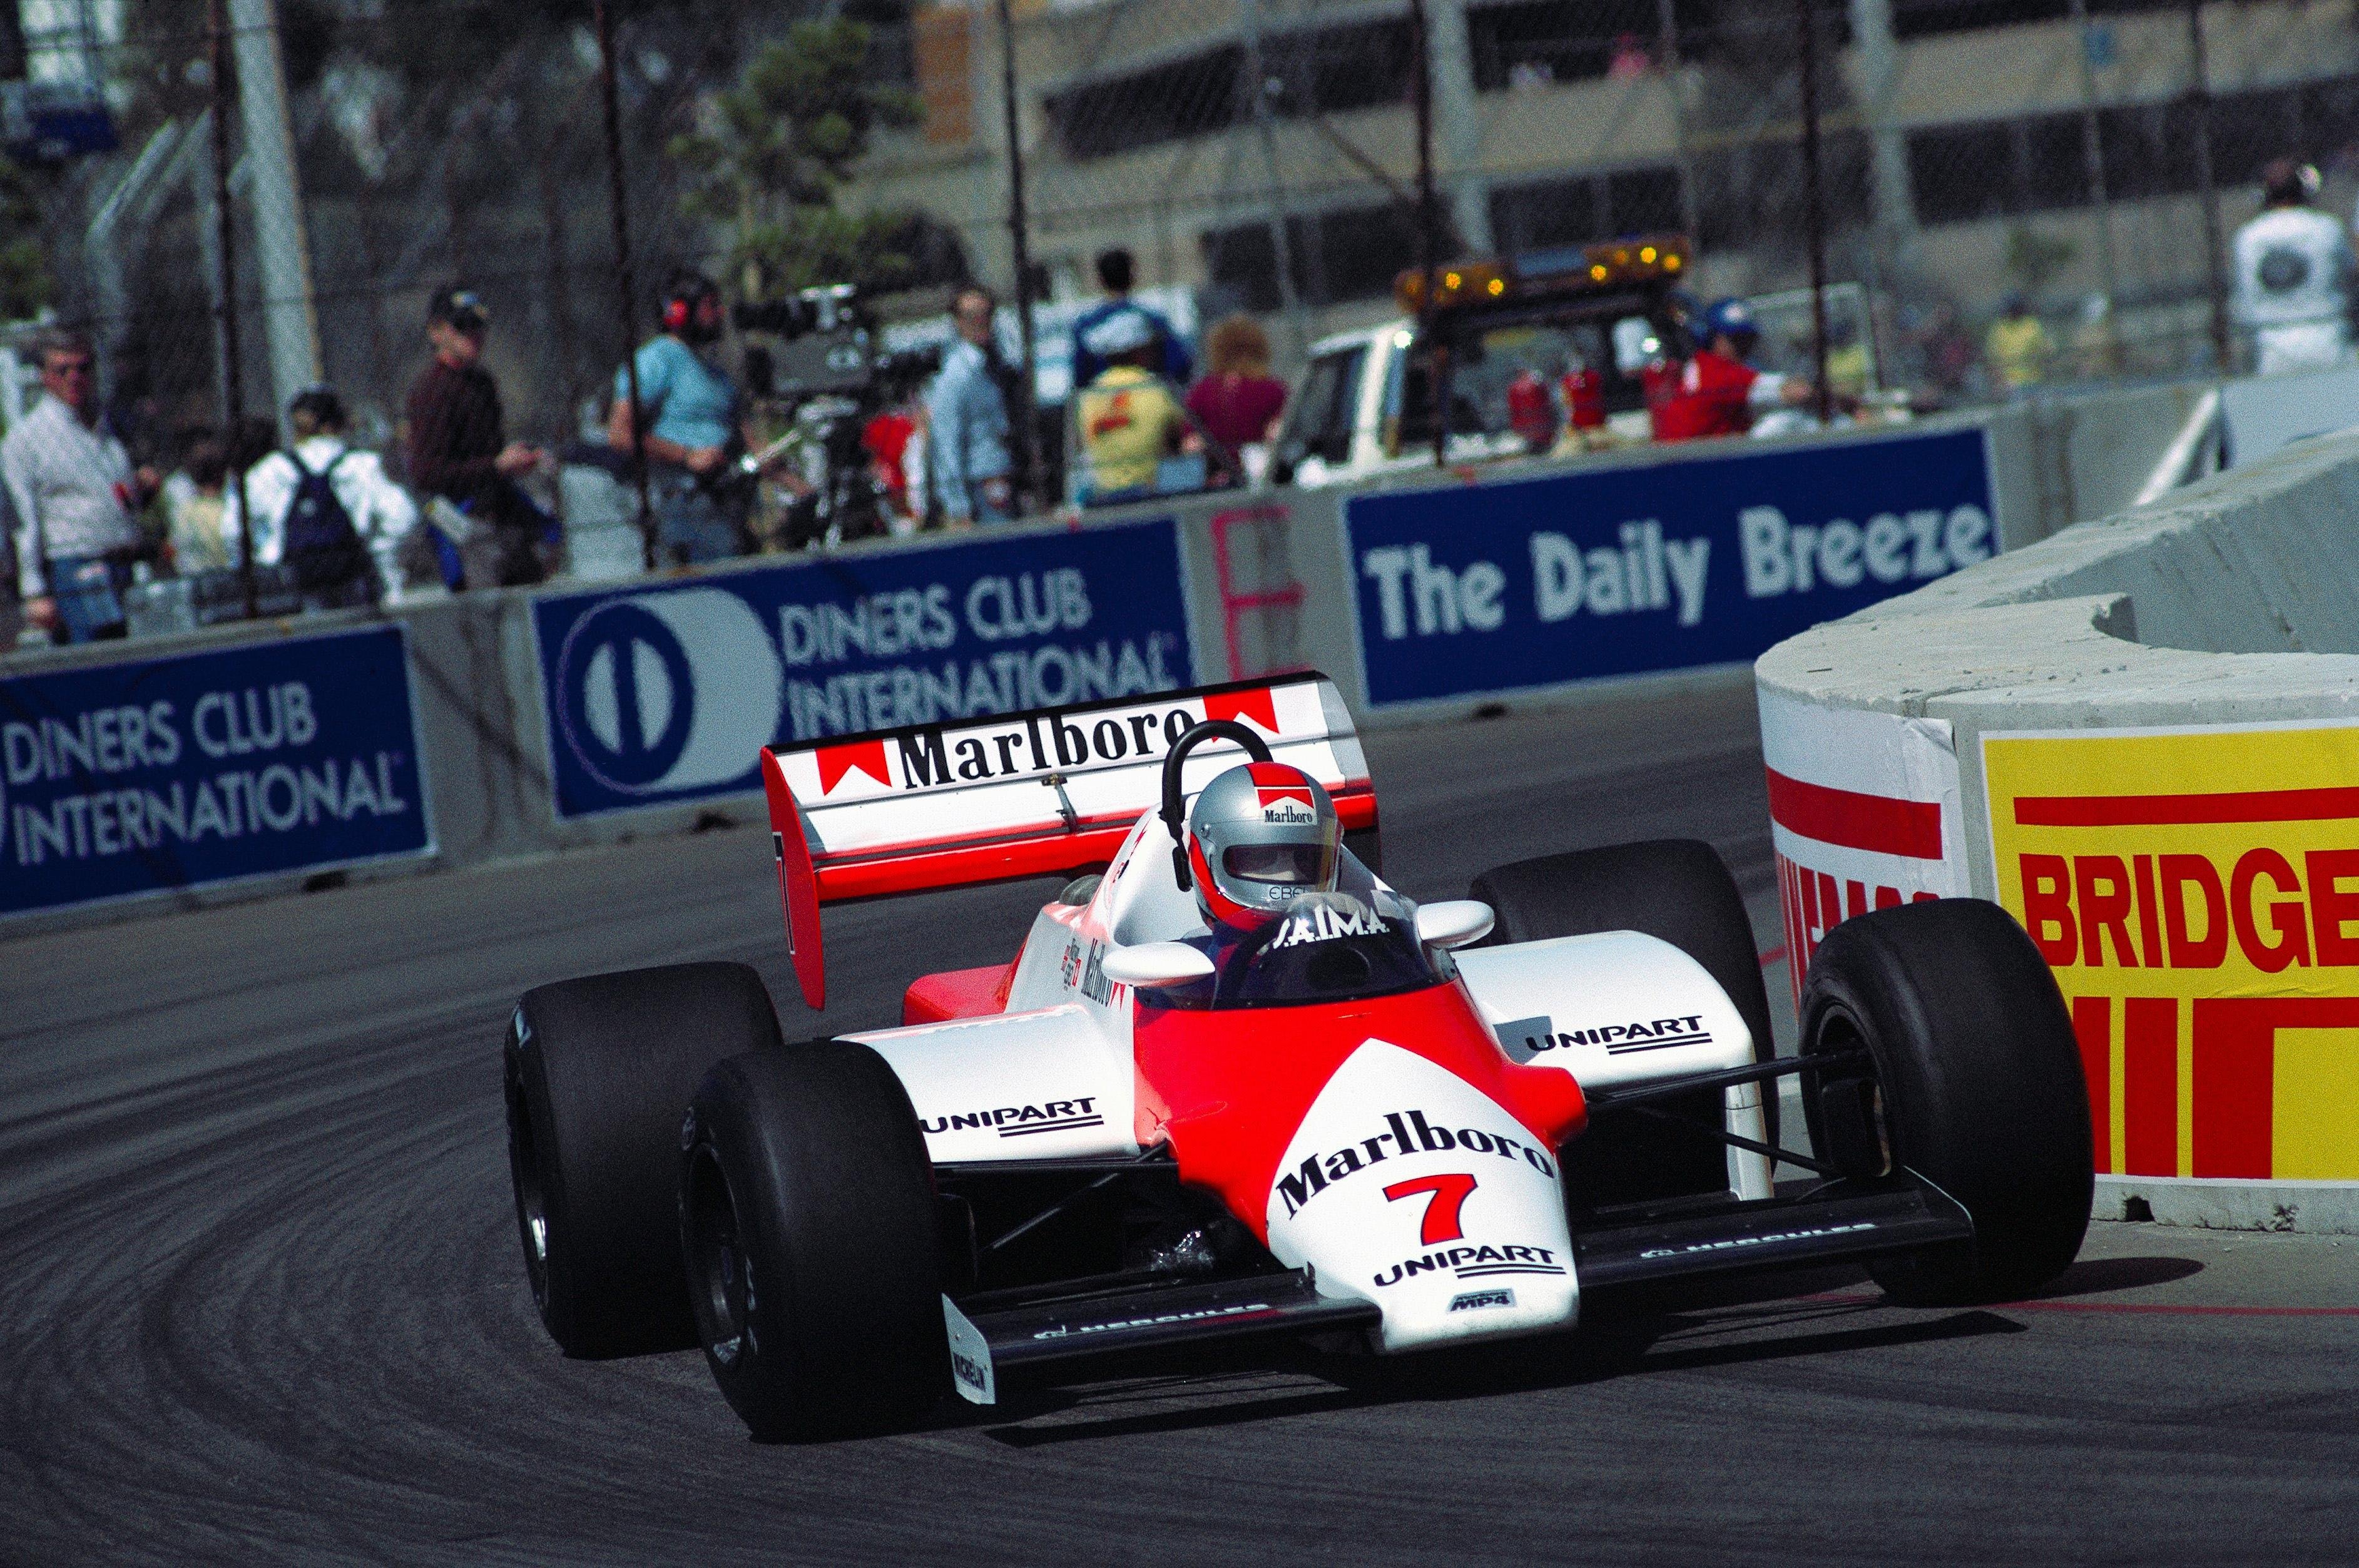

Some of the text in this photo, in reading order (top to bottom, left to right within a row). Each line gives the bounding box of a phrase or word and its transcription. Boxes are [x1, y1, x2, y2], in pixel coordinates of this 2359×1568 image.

[1363, 504, 1991, 639] The Daily Breeze
[778, 568, 1093, 666] DINERS CLUB
[786, 631, 1179, 740] INTERNATIONAL
[2, 681, 316, 786] DINERS CLUB
[895, 707, 1196, 789] Marlboro
[11, 752, 407, 865] INTERNATIONAL
[1265, 805, 1313, 823] Marlboro
[2019, 847, 2359, 973] BRIDGE
[1526, 1016, 1703, 1052] UNIPART
[918, 1097, 1096, 1134] UNIPART
[1275, 1109, 1556, 1220] Marlboro
[1383, 1173, 1478, 1246] 7
[1374, 1246, 1554, 1287] UNIPART
[1450, 1295, 1511, 1311] MP4
